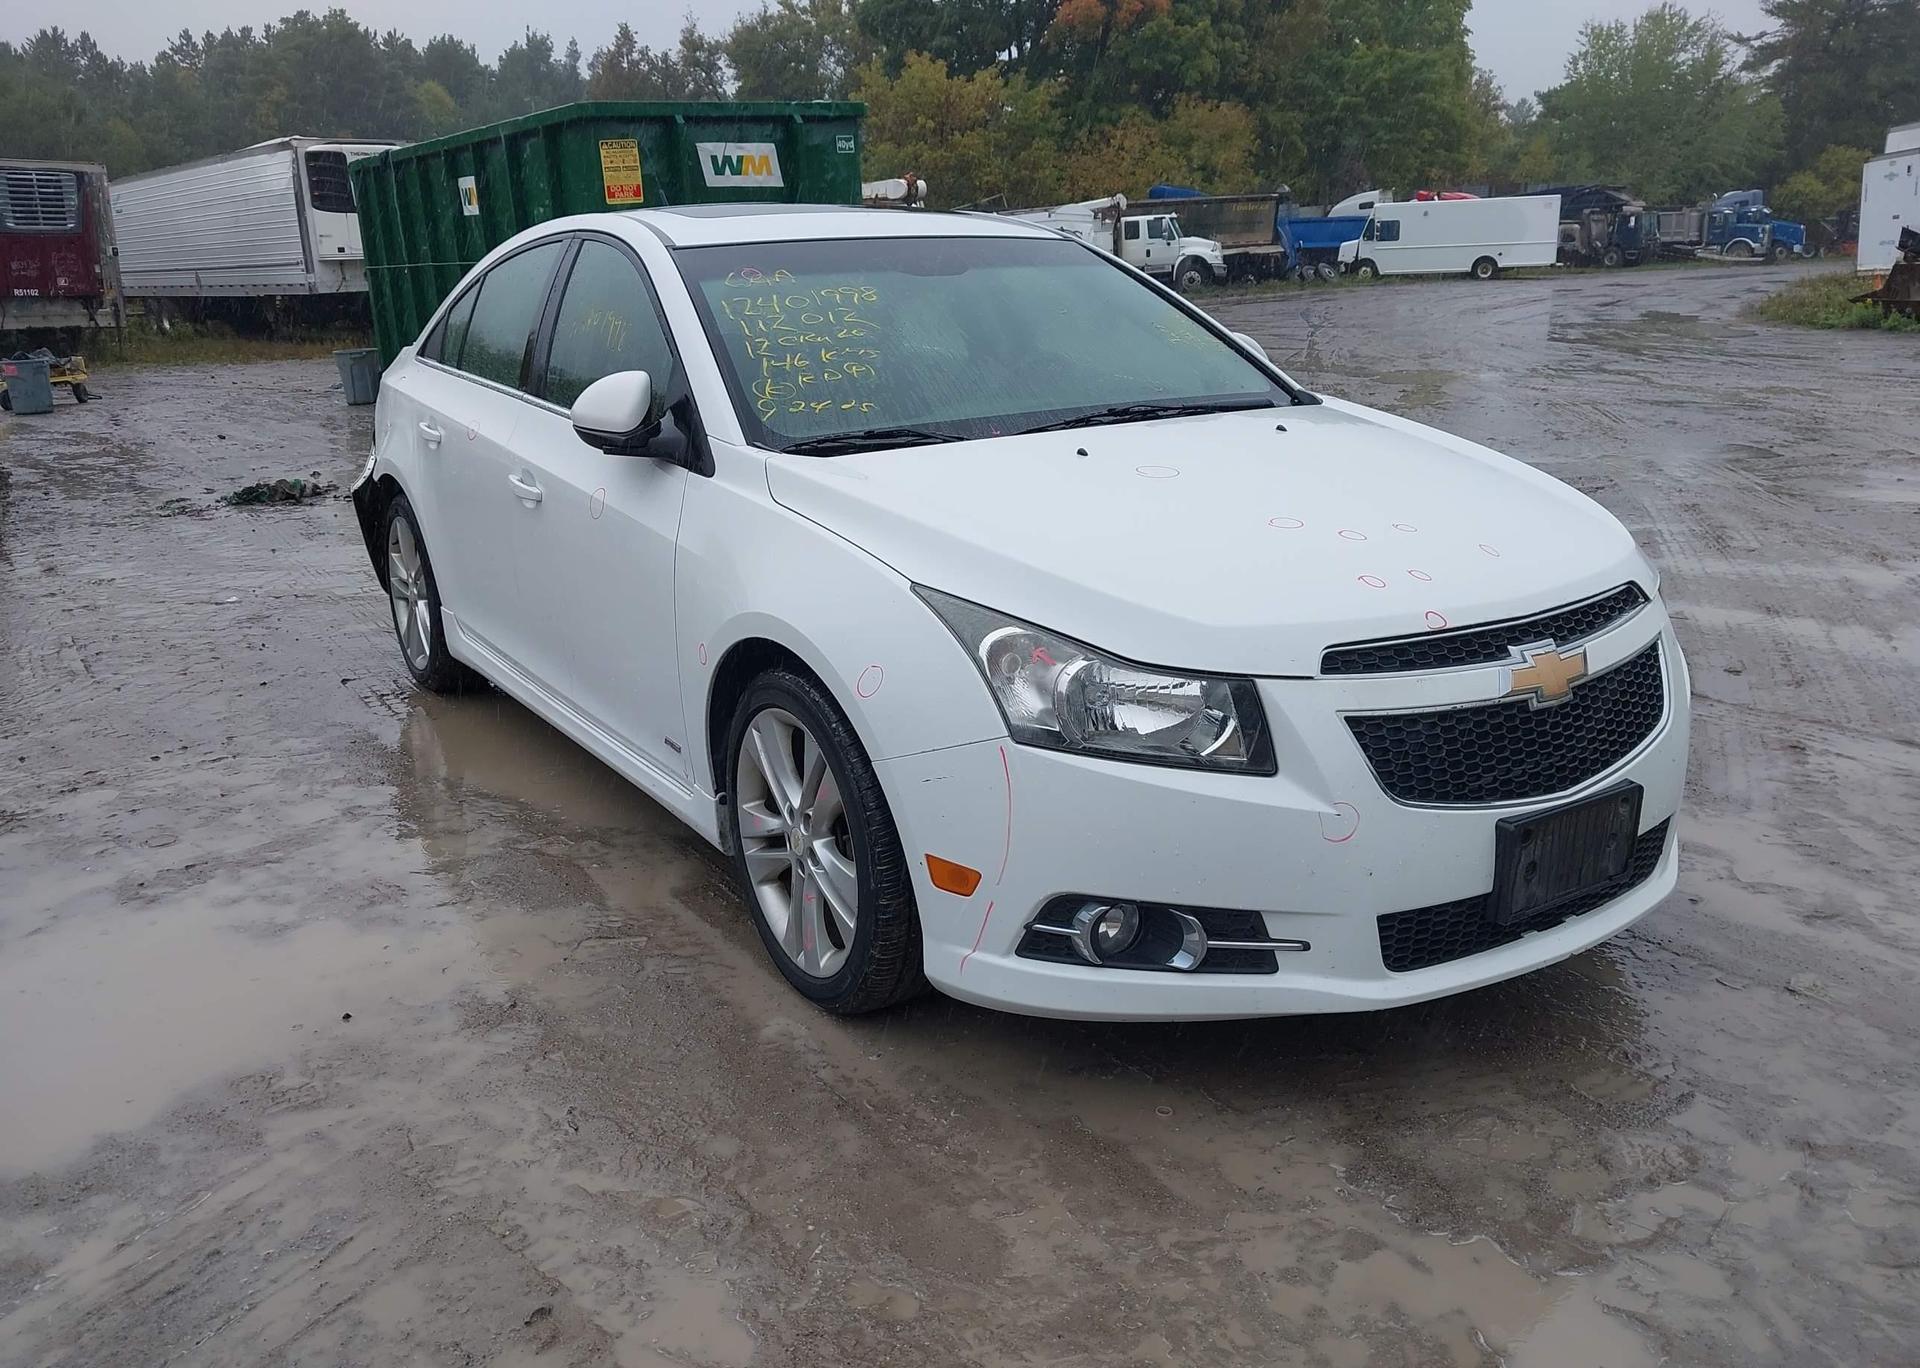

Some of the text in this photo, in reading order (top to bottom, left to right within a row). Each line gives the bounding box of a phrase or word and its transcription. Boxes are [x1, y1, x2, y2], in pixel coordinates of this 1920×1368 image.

[607, 141, 636, 149] CAUTION
[710, 155, 773, 176] WM
[614, 190, 635, 198] PARK
[721, 286, 877, 320] 12401998
[745, 337, 776, 359] 12
[762, 352, 809, 377] 146
